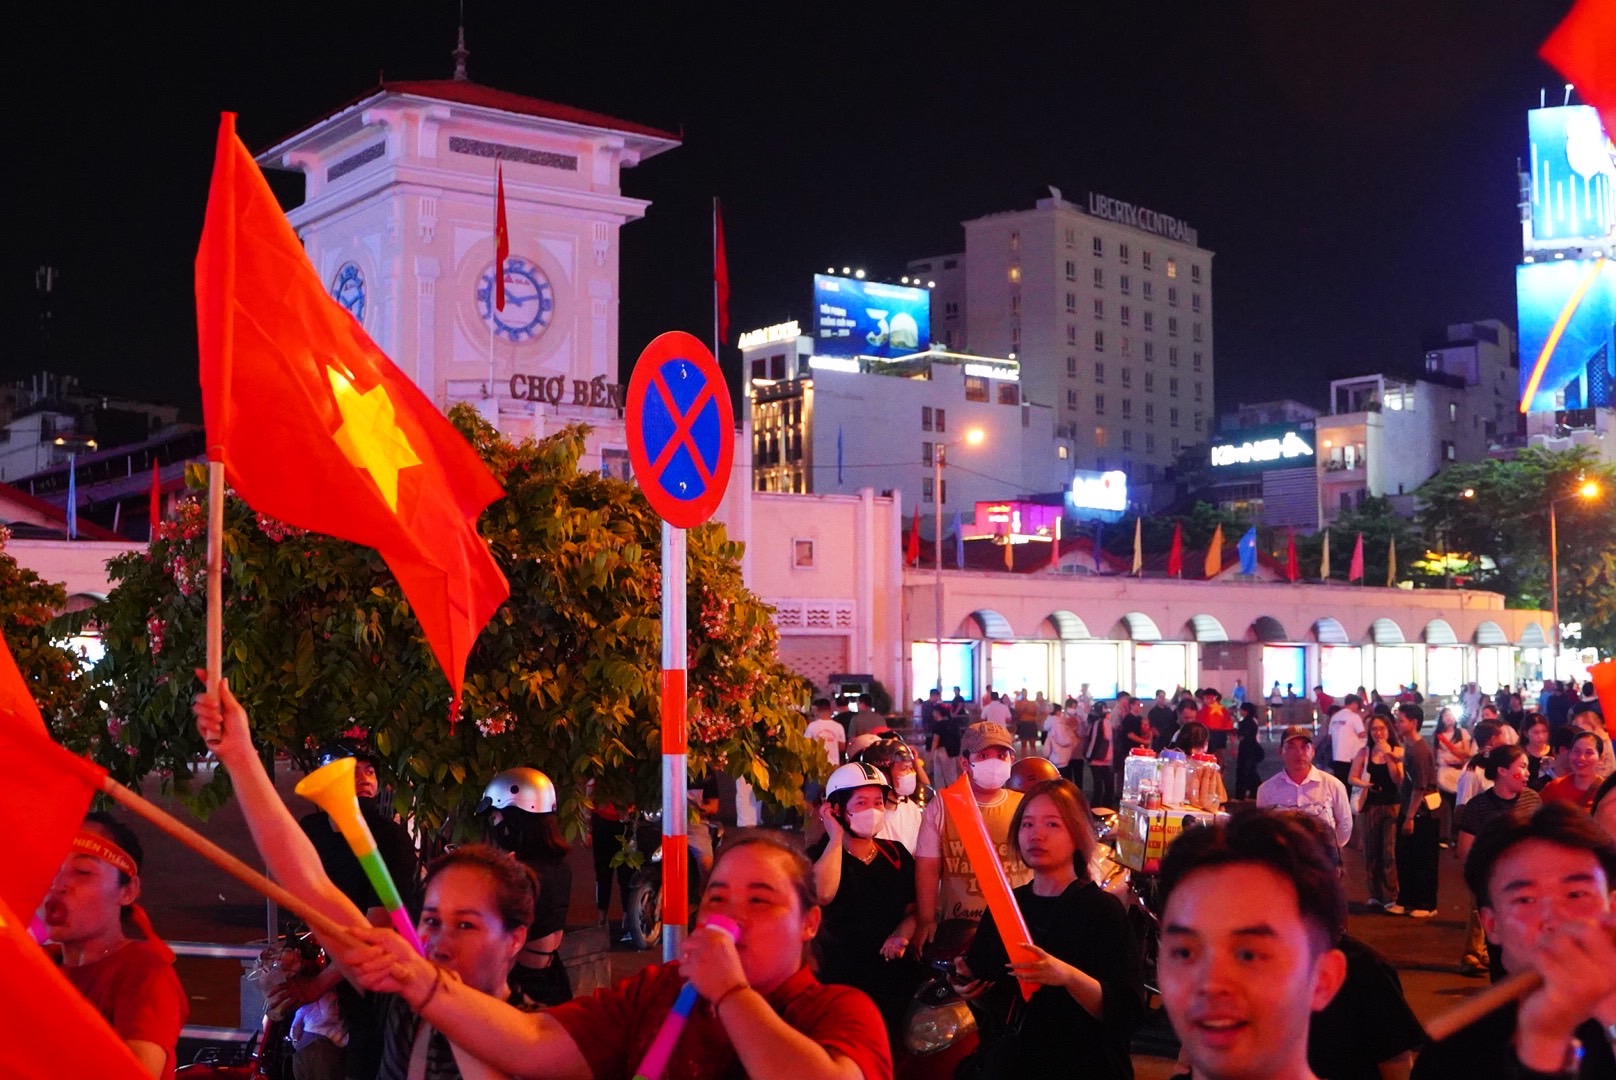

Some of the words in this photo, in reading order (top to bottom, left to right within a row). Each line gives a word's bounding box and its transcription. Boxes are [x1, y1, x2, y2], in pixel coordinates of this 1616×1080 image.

[1089, 191, 1137, 226] LIBERTY
[1138, 207, 1191, 243] CENTRAL
[509, 373, 566, 406] CHỢ
[73, 836, 102, 853] HIẾN
[952, 901, 982, 918] Cam
